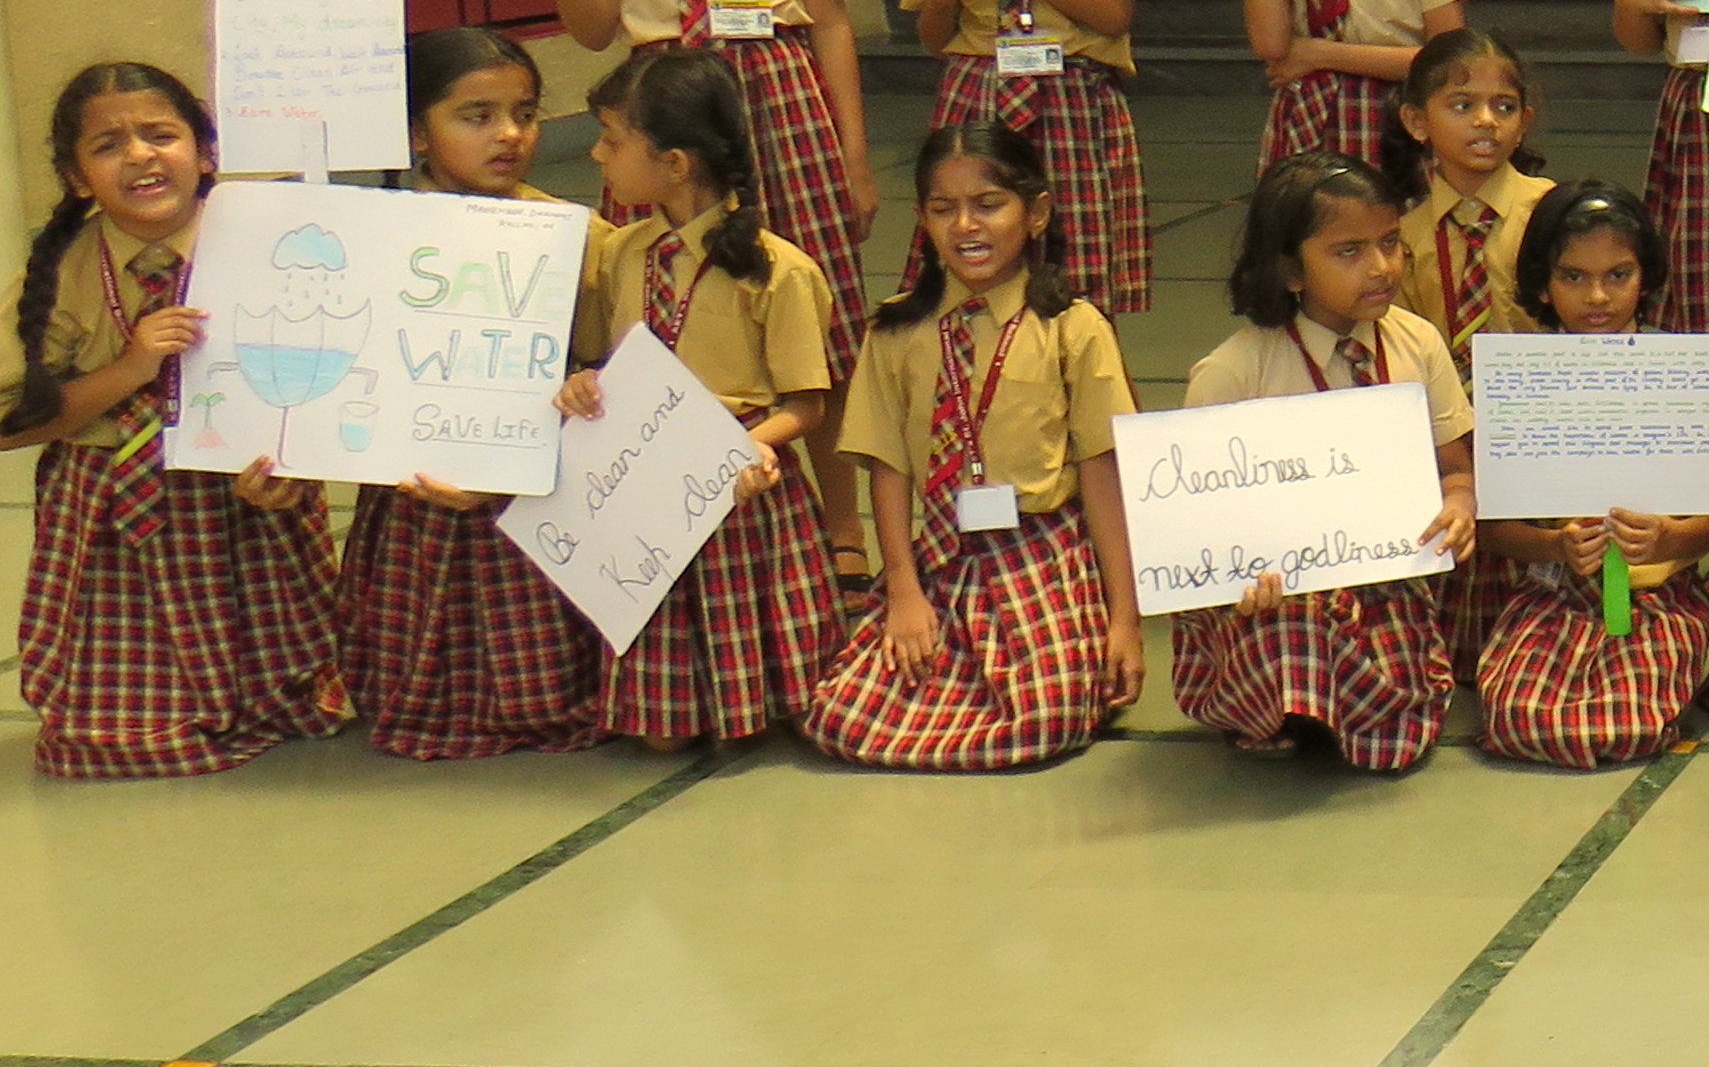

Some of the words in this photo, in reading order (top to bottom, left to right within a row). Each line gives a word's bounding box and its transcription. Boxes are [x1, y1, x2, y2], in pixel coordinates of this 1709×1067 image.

[535, 521, 581, 566] Be
[640, 385, 687, 443] and
[1325, 448, 1361, 479] is
[599, 533, 675, 604] Keep
[1138, 547, 1221, 592] next
[1226, 544, 1273, 582] to
[1280, 529, 1420, 591] godliness
